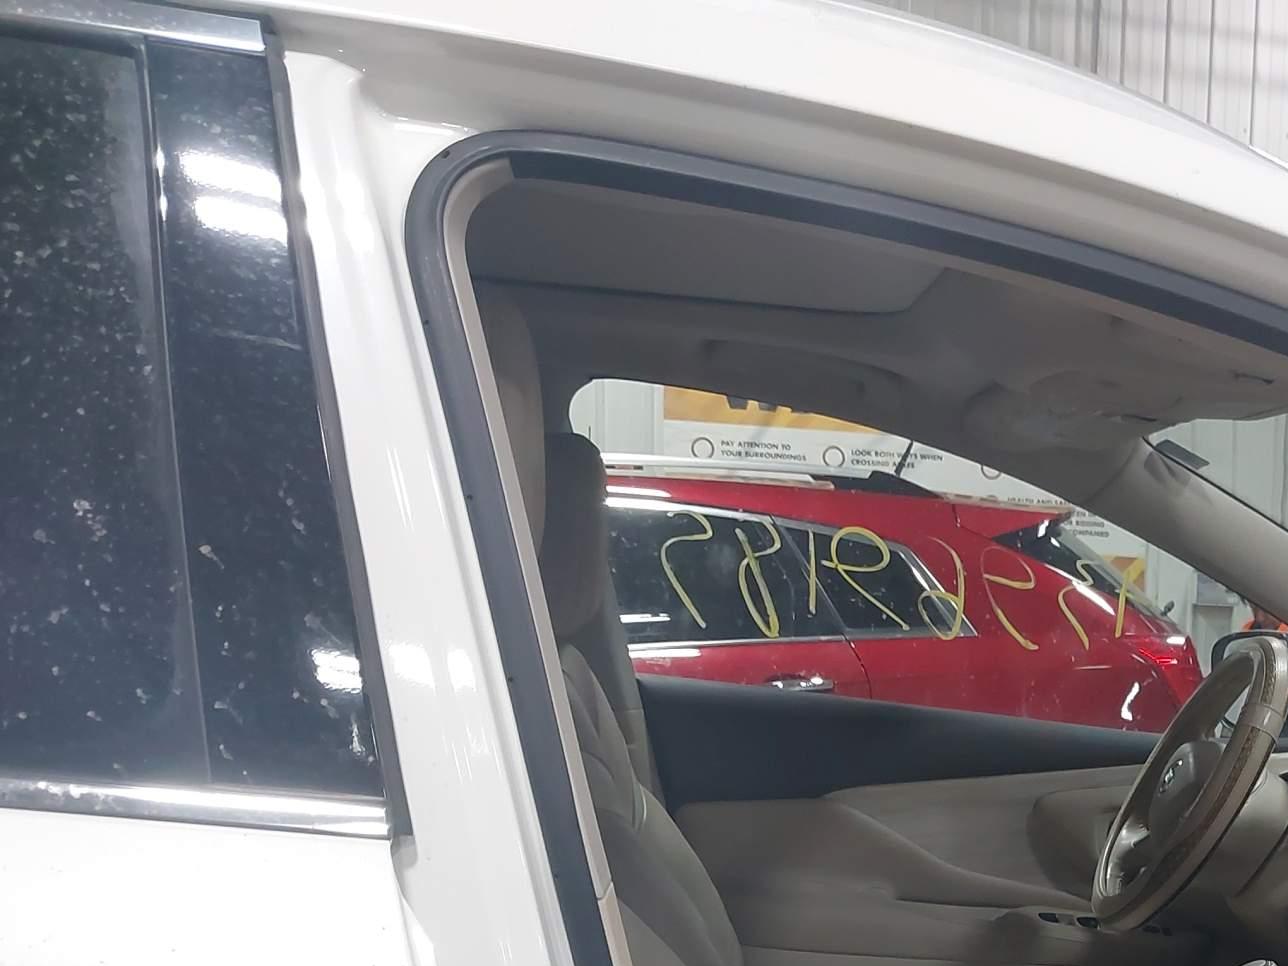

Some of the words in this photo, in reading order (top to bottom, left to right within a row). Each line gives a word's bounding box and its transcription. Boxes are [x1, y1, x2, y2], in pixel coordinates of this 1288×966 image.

[737, 441, 779, 450] ATTENTION
[720, 449, 742, 457] YOUR
[744, 451, 807, 461] SURROUNDINGS
[919, 453, 943, 461] WHEN
